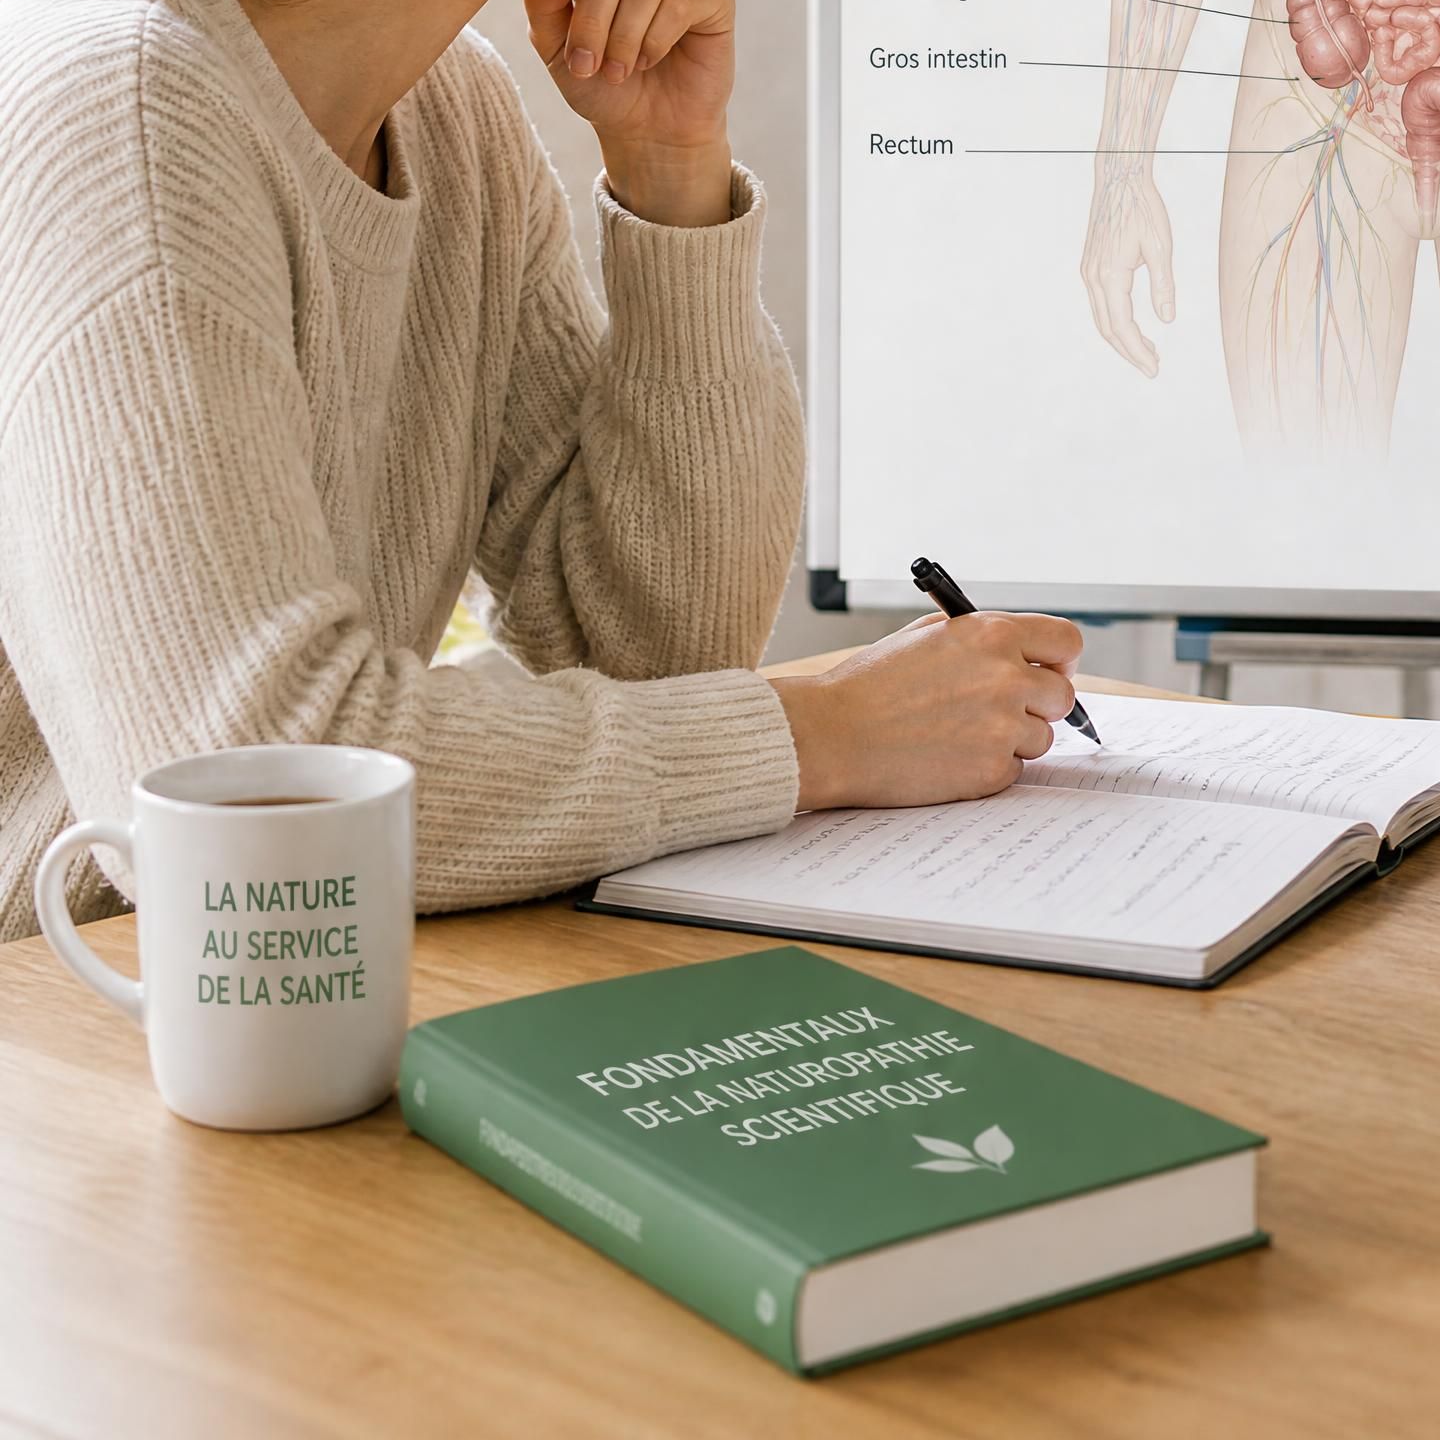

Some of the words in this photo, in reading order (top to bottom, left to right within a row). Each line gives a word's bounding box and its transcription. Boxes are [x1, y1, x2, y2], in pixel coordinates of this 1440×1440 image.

[870, 48, 919, 68] Gros
[929, 48, 1006, 68] intestin
[871, 134, 952, 154] Rectum
[205, 882, 237, 912] LA
[247, 876, 356, 912] NATURE
[202, 930, 237, 959] AU
[247, 925, 359, 961] SERVICE
[198, 974, 230, 1004] DE
[240, 977, 271, 1005] LA
[280, 960, 366, 1005] SANTÉ
[576, 1007, 896, 1097] FONDAMENTAUX
[622, 1100, 683, 1129] DE
[671, 1090, 729, 1115] LA
[717, 1029, 975, 1104] NATUROPATHIE
[719, 1071, 967, 1147] SCIENTIFIQUE
